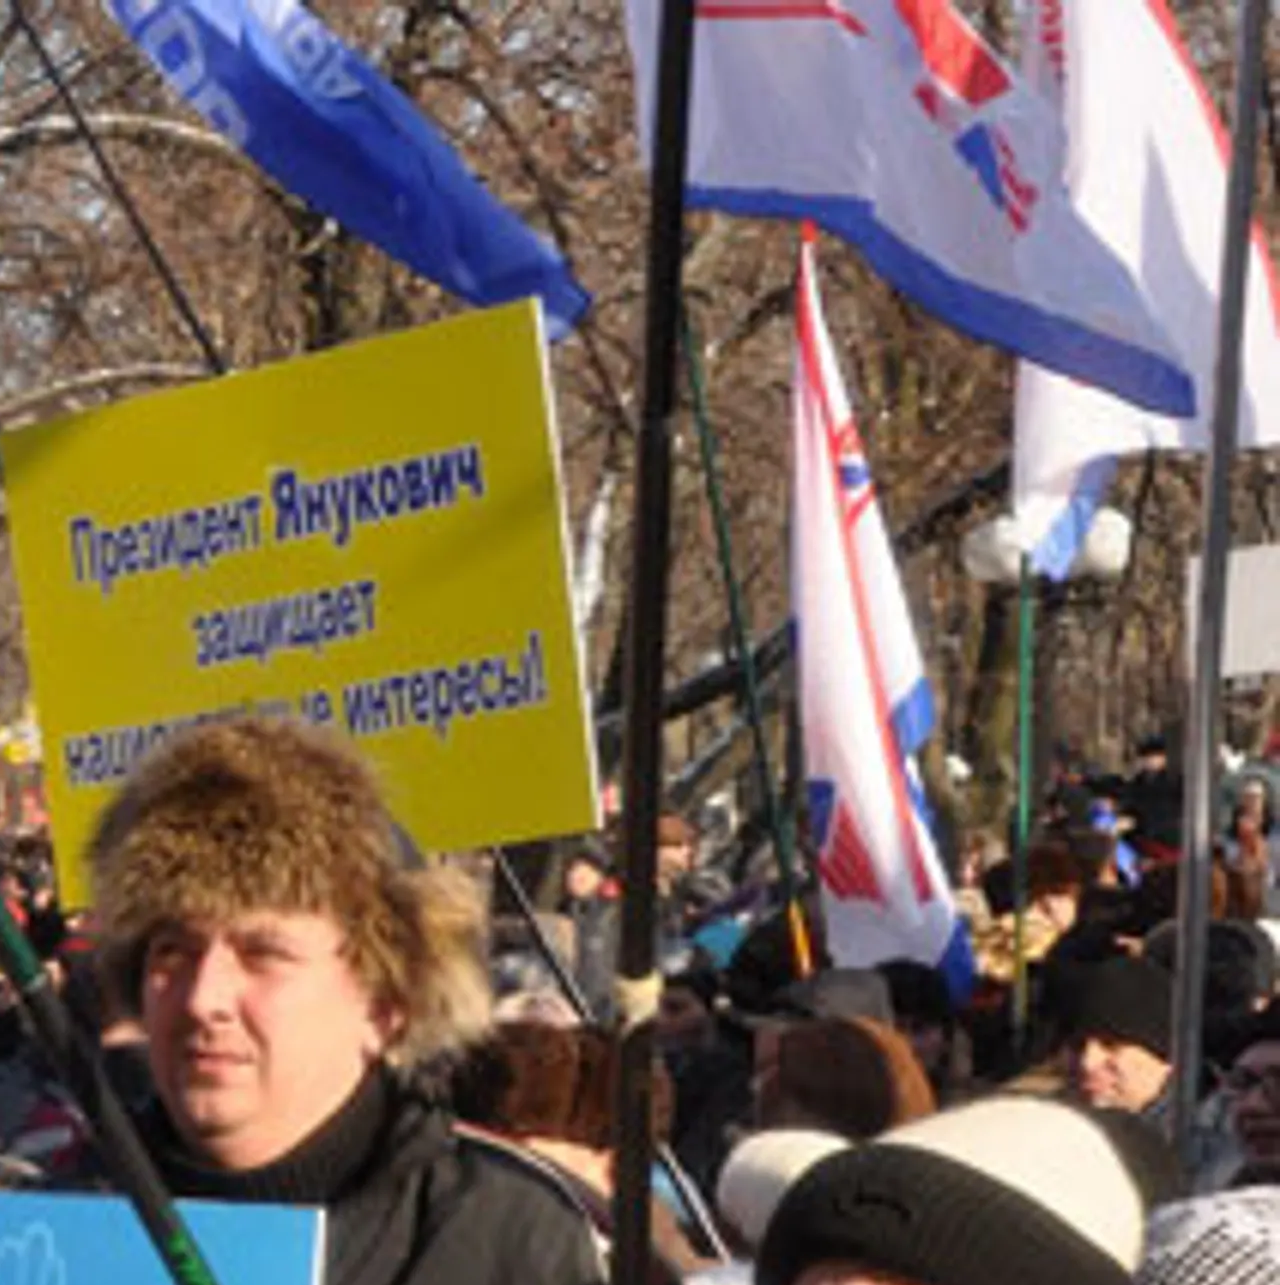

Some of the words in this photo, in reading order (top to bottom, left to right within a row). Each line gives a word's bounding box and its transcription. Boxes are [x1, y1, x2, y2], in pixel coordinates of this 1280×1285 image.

[69, 496, 262, 592] Президент
[269, 444, 483, 545] Янукович
[193, 581, 377, 667] защищает
[344, 631, 547, 737] интересы!
